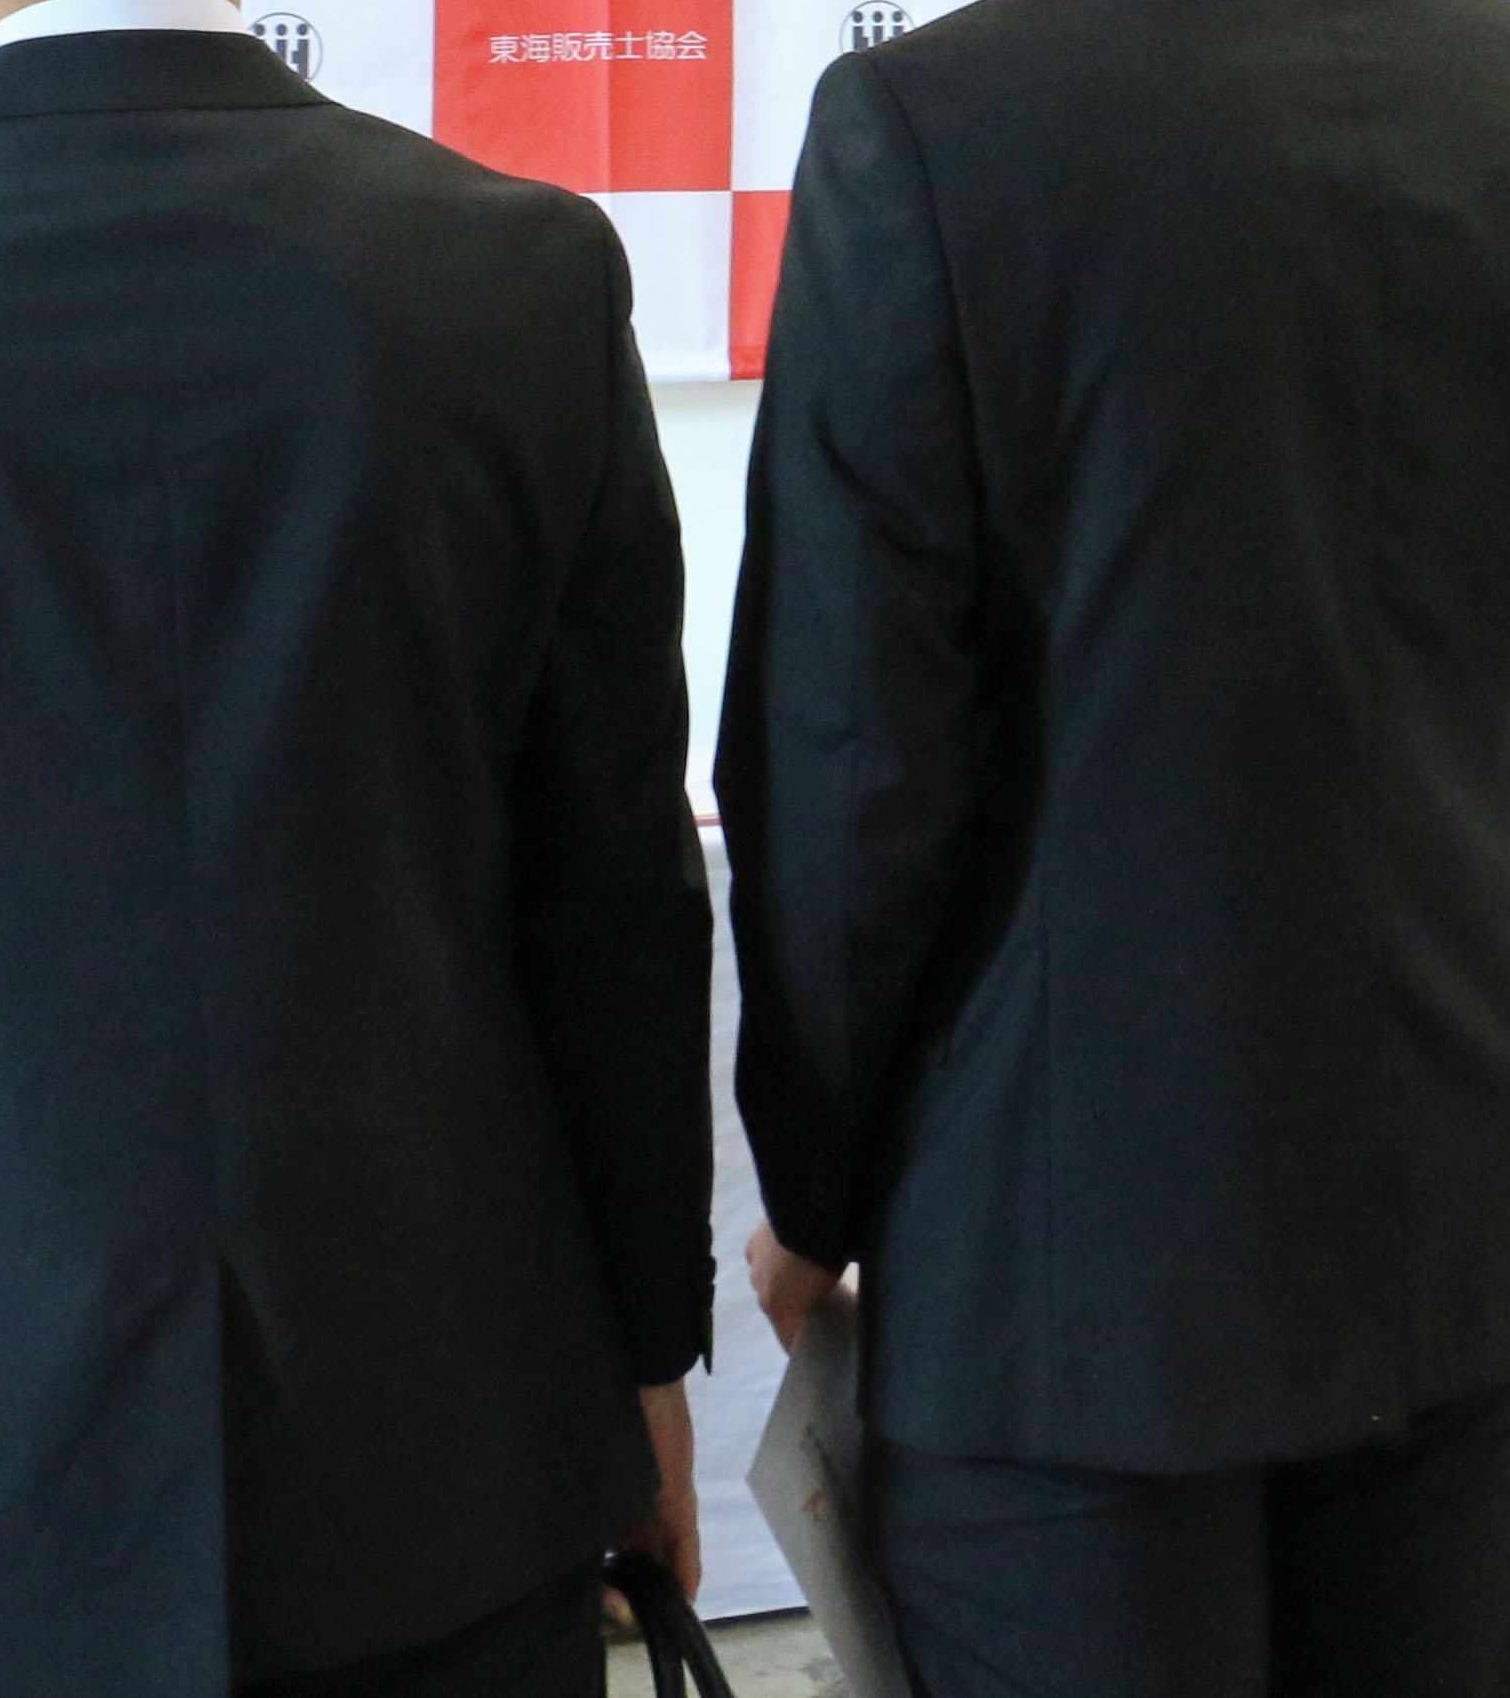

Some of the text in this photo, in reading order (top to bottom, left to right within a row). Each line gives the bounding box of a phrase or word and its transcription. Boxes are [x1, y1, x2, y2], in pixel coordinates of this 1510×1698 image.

[488, 29, 708, 64] 東海販売士協会
